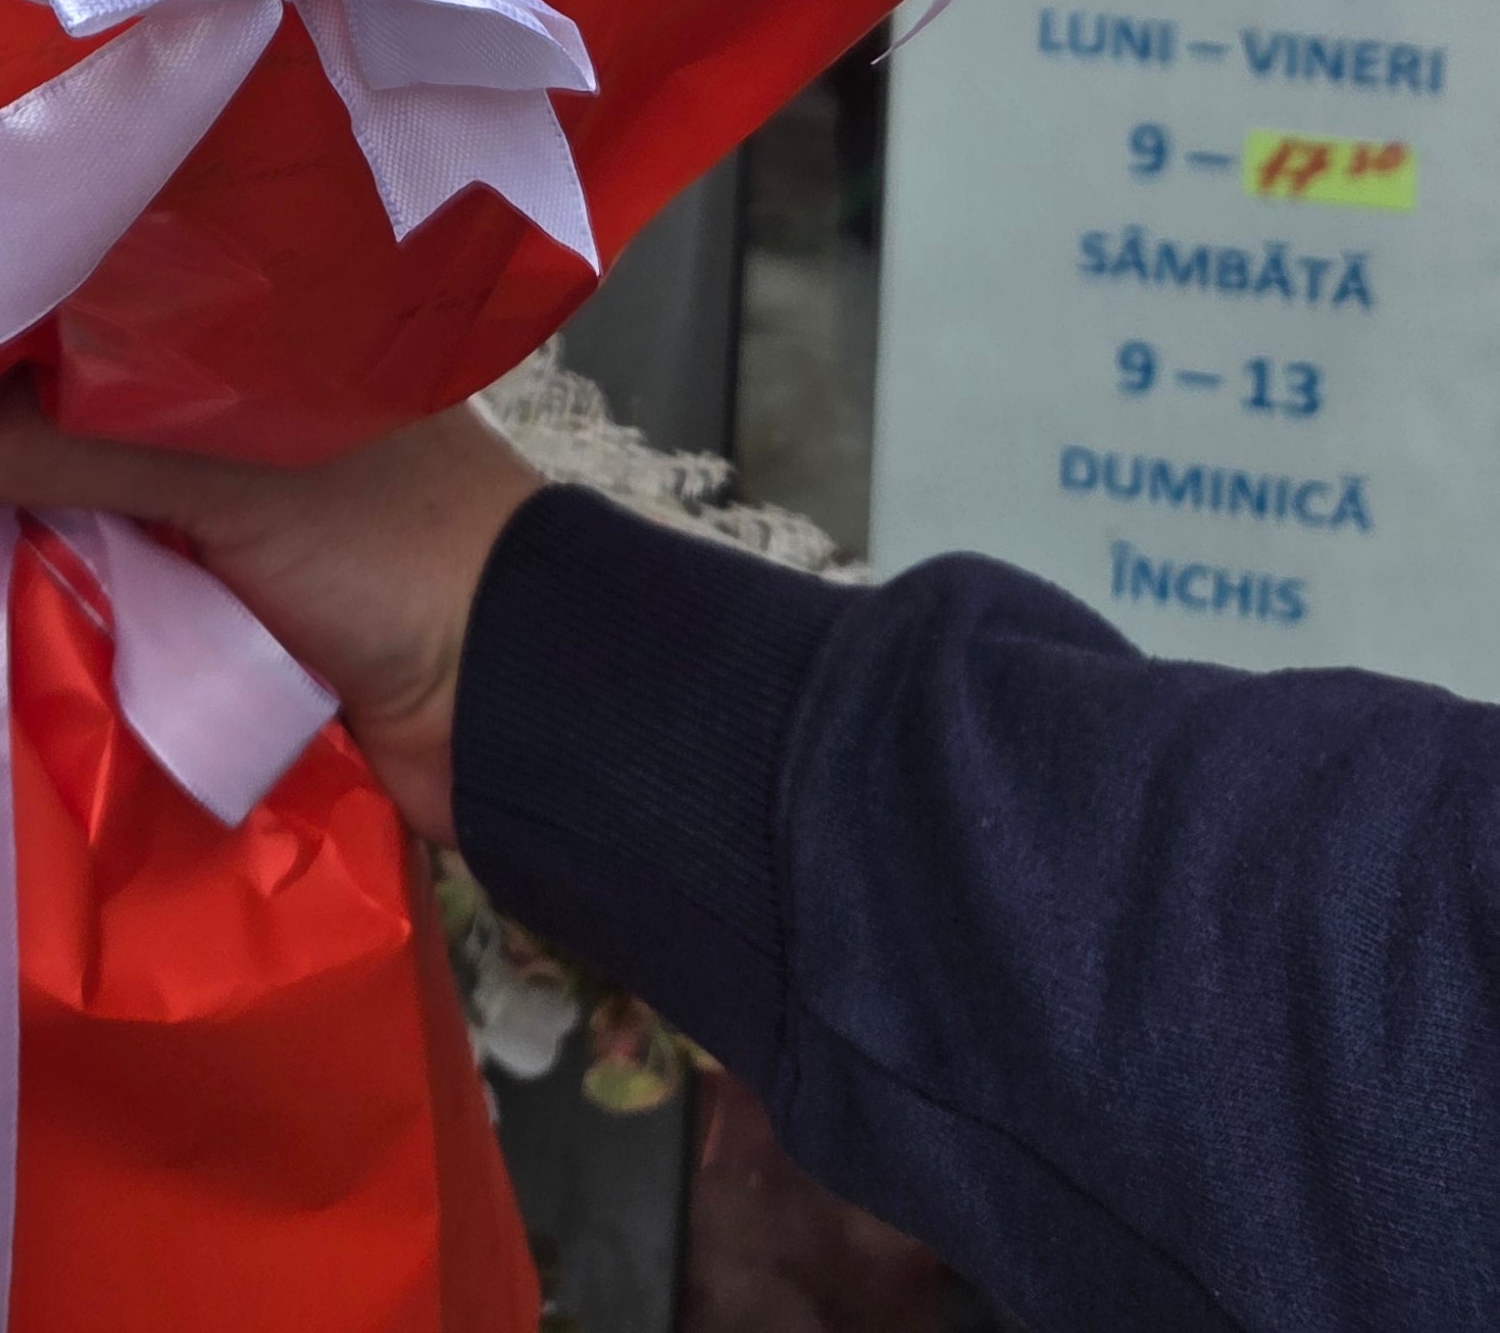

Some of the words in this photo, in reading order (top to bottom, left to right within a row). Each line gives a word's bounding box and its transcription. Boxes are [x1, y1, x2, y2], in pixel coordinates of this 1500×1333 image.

[1037, 10, 1174, 64] LUNI
[1240, 30, 1444, 94] VINERI
[1127, 121, 1172, 179] 9
[1115, 339, 1159, 396] 9
[1243, 356, 1324, 419] 13
[1058, 445, 1372, 533] DUMINICĂ
[1111, 543, 1307, 624] ÎNCHIS
